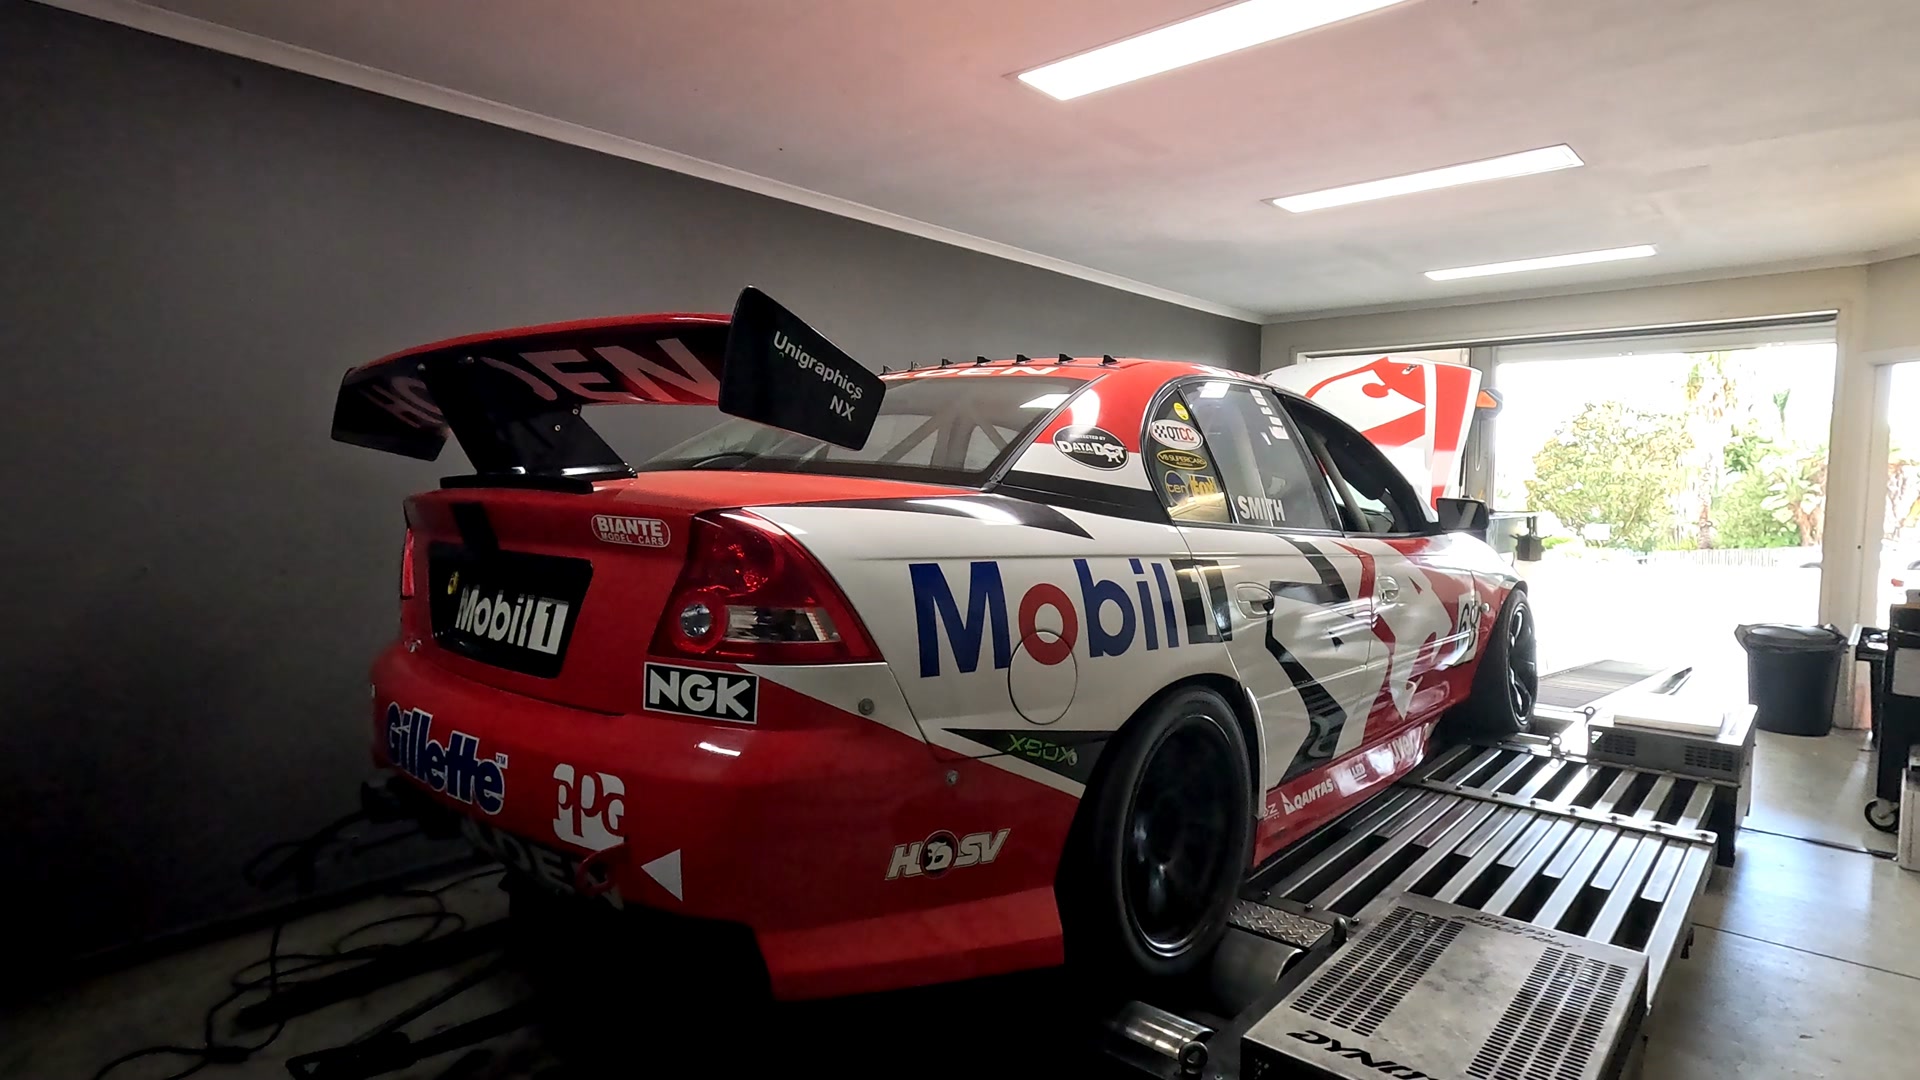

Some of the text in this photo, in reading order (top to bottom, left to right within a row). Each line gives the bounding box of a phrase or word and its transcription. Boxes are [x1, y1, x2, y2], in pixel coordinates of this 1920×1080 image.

[773, 330, 864, 400] Unigraphics
[829, 395, 856, 421] NX
[596, 516, 663, 537] BIANTE
[1238, 495, 1286, 521] SMITH
[600, 531, 665, 545] MODEL CARS
[455, 585, 536, 647] Mobil
[909, 558, 1180, 678] Mobil
[649, 668, 751, 718] NGK
[386, 701, 506, 815] Gillette
[1293, 778, 1335, 809] QANTAS
